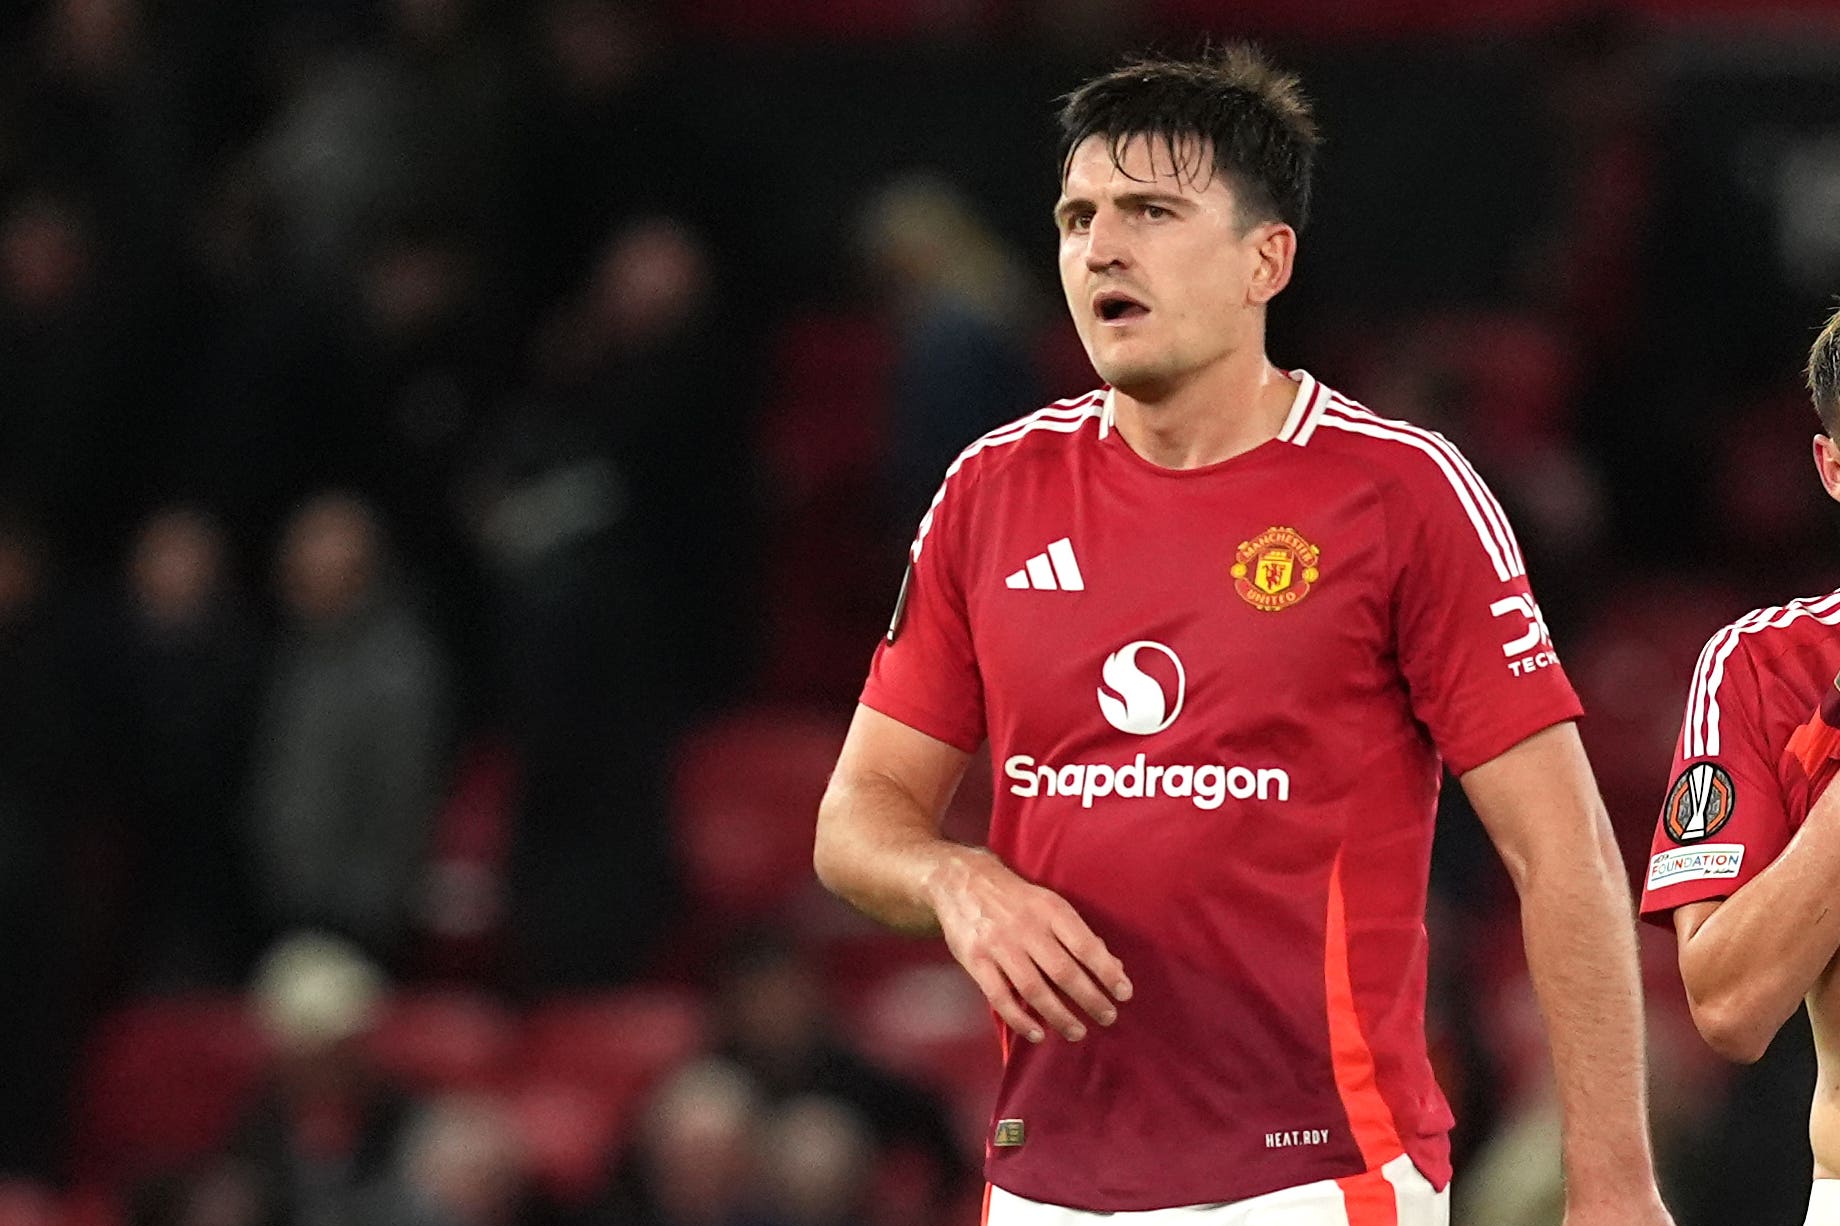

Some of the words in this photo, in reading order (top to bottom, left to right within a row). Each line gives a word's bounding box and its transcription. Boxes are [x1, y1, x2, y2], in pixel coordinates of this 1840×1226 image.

[1004, 752, 1290, 809] Snapdragon
[1651, 854, 1740, 877] FOUNDATION
[1265, 1128, 1329, 1148] HEAT.RDY
